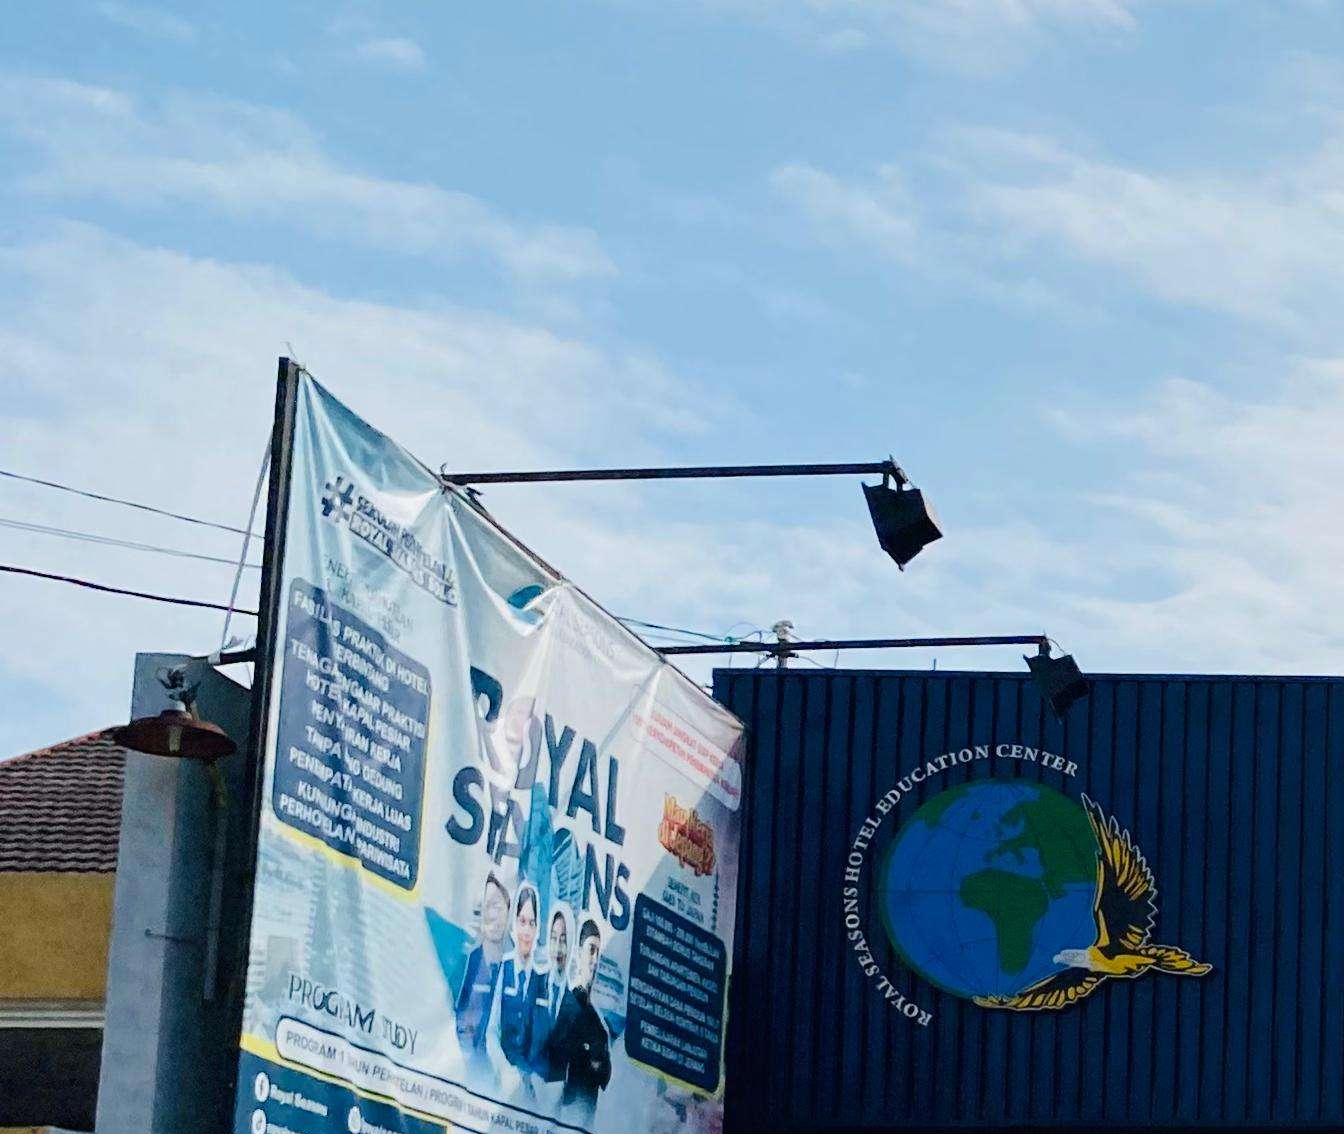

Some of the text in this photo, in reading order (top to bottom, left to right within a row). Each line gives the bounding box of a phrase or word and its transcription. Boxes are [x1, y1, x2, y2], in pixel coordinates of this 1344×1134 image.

[385, 806, 412, 831] LUAS
[843, 743, 1079, 1027] ROYAL SEASONS HOTEL EDUCATION CENTER
[382, 1015, 419, 1055] TUDY
